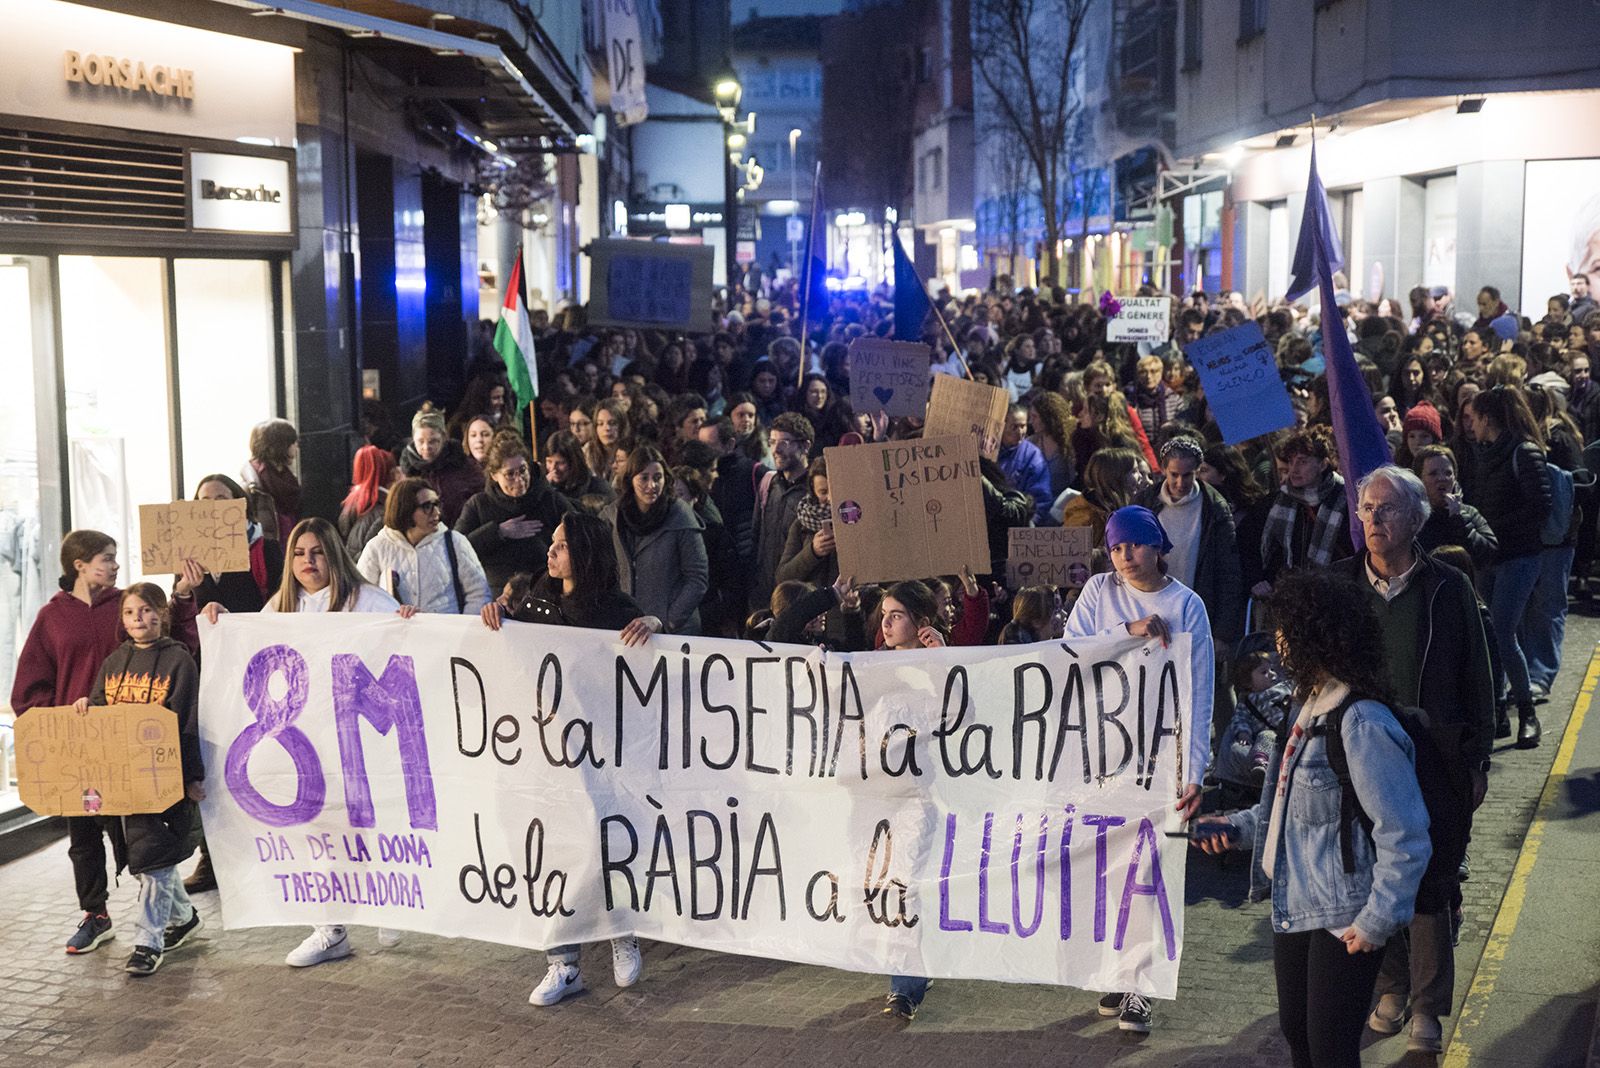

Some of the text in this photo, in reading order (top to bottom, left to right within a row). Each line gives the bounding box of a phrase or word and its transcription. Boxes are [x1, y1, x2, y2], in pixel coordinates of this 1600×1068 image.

[63, 50, 195, 100] BORSACHE
[201, 179, 281, 203] Borsache
[1117, 299, 1161, 307] GUALTAT
[859, 370, 882, 384] PER
[884, 470, 920, 491] LAS
[1012, 530, 1080, 544] LES DONES
[38, 713, 122, 744] FEMINISME
[450, 656, 522, 766] De
[531, 653, 606, 770] la
[879, 724, 924, 778] a
[932, 664, 1004, 779] la
[224, 643, 438, 832] 8M
[310, 833, 337, 862] DE
[344, 832, 372, 862] LA
[380, 834, 432, 868] DONA
[459, 812, 519, 910] de
[522, 817, 576, 919] la
[805, 870, 846, 923] a
[863, 818, 920, 928] la
[274, 872, 425, 910] TREBALLADORA
